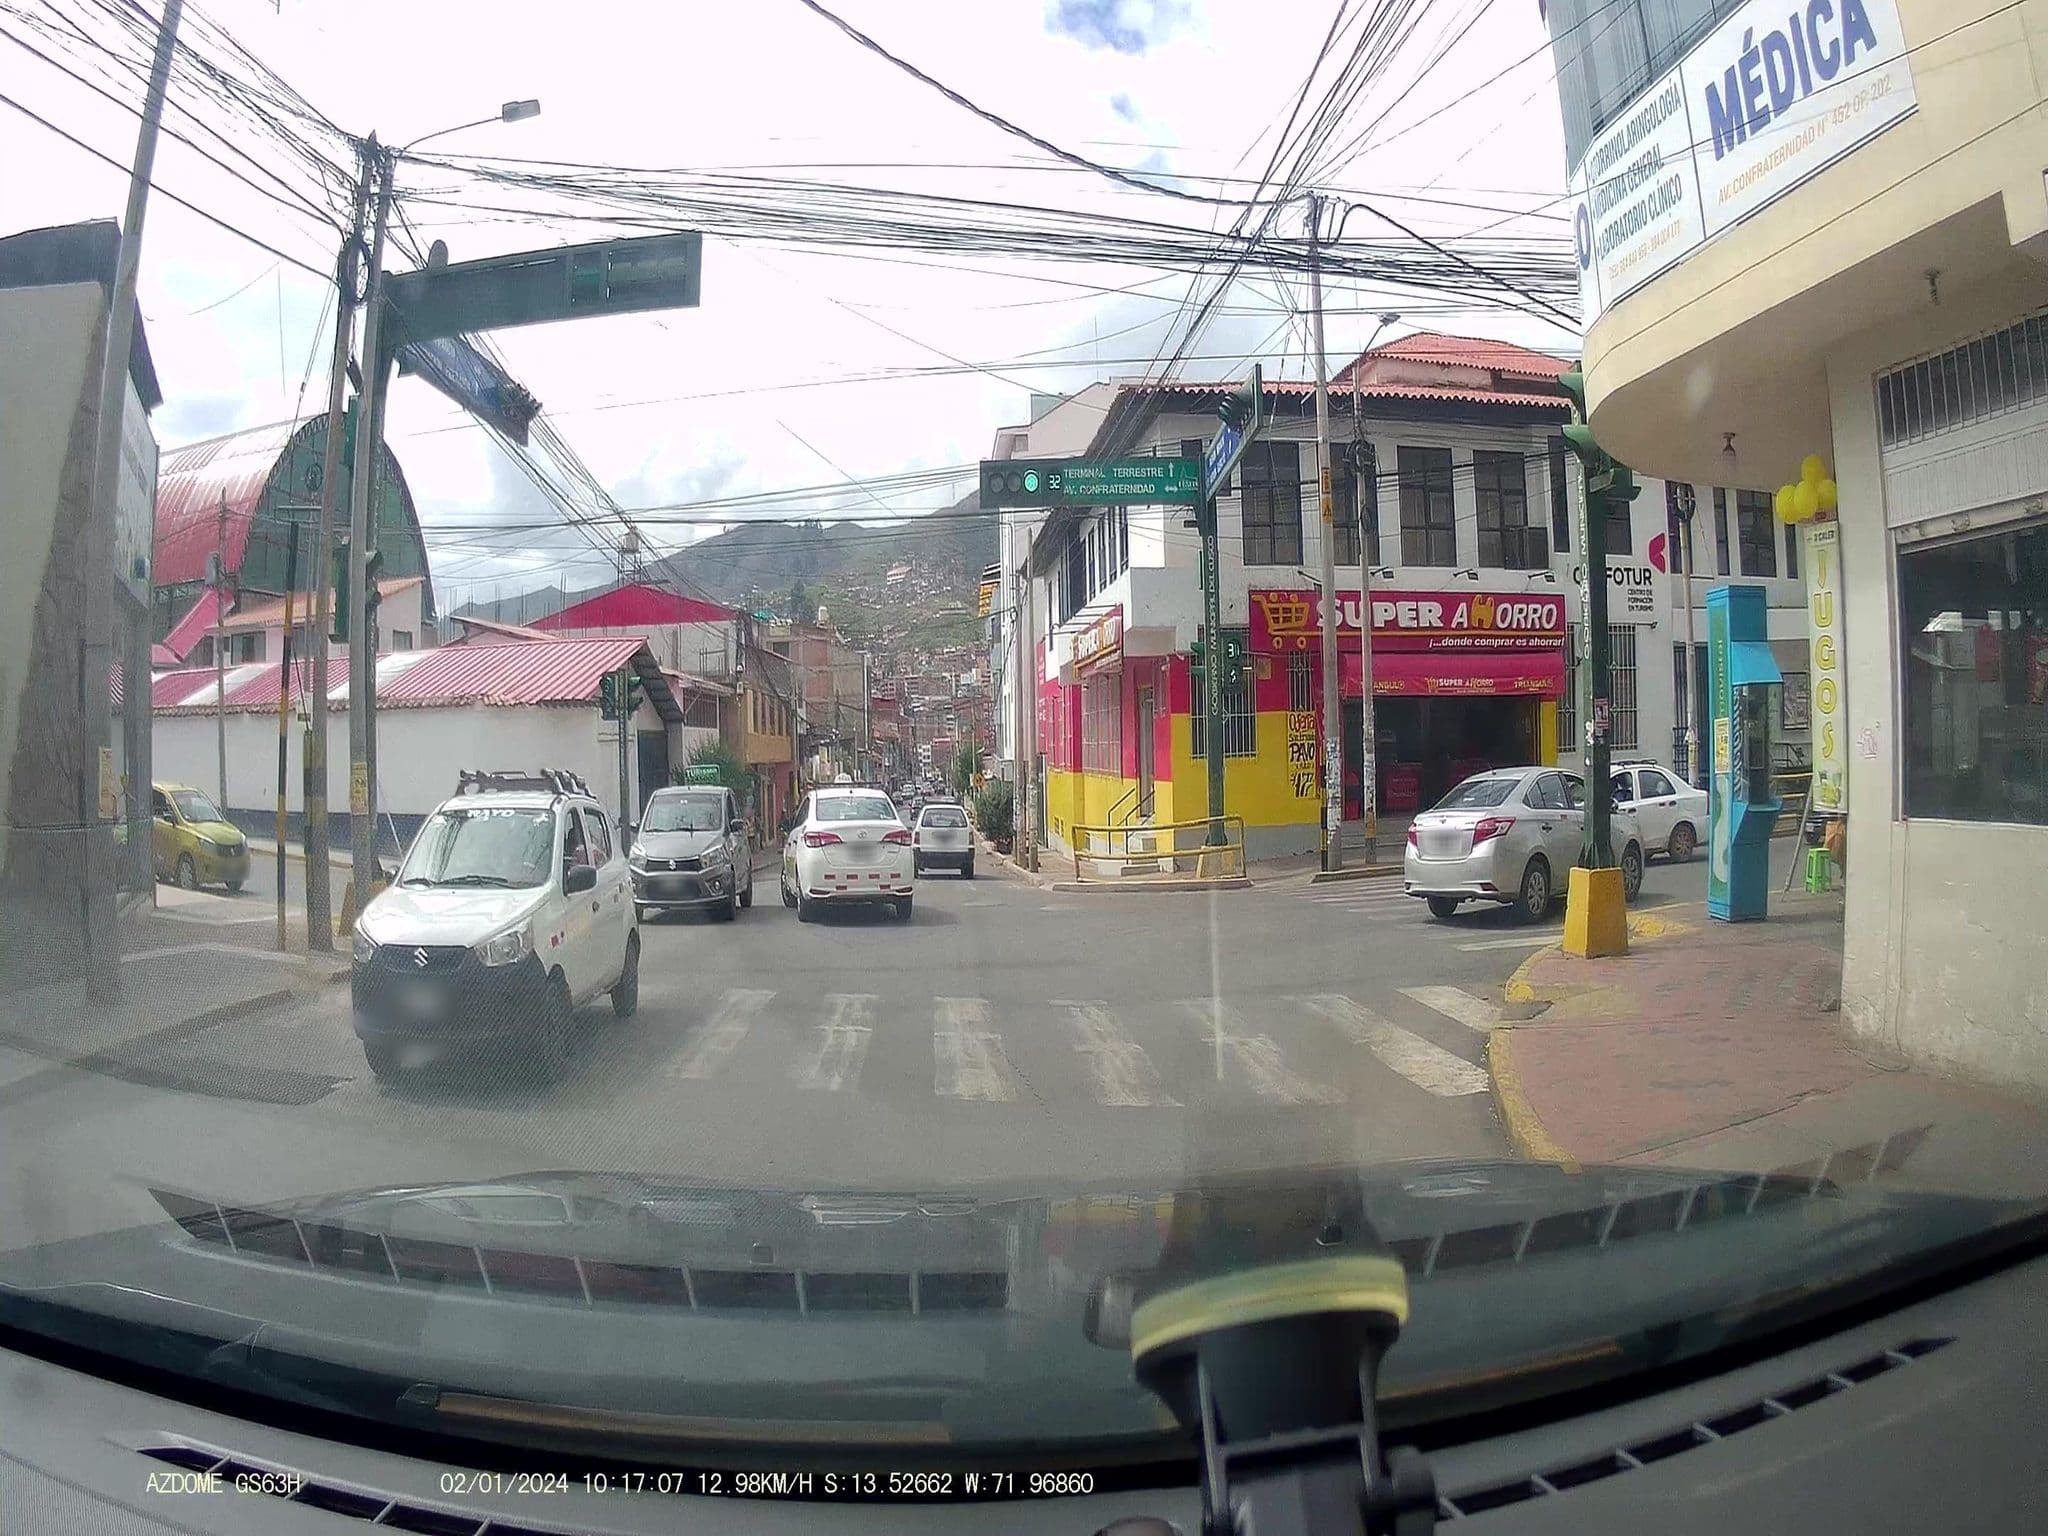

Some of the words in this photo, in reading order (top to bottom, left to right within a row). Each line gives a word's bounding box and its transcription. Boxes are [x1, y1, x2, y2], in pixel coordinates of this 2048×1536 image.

[1705, 0, 1877, 161] MÉDICA
[1733, 126, 1815, 194] CONFRATERNIDAD
[1871, 75, 1892, 100] 202
[1594, 174, 1628, 223] MEDICINA
[1627, 144, 1665, 184] GENERAL
[1600, 202, 1647, 261] LABORATORIO
[1648, 172, 1683, 221] CLÍNICO
[1049, 474, 1061, 489] 32
[1064, 468, 1106, 478] TERMINAL
[1113, 467, 1164, 477] TERRESTRE
[1080, 483, 1155, 494] CONFRATERNIDAD
[1207, 535, 1215, 571] CUSCO
[1452, 595, 1558, 630] AHORRO
[1474, 638, 1514, 648] comprar
[1516, 638, 1527, 646] es
[1529, 636, 1565, 647] ahorrar!
[1813, 549, 1836, 758] JUGOS
[1439, 679, 1463, 687] SUPER
[1289, 743, 1315, 762] PAVO
[467, 809, 515, 820] RAYO
